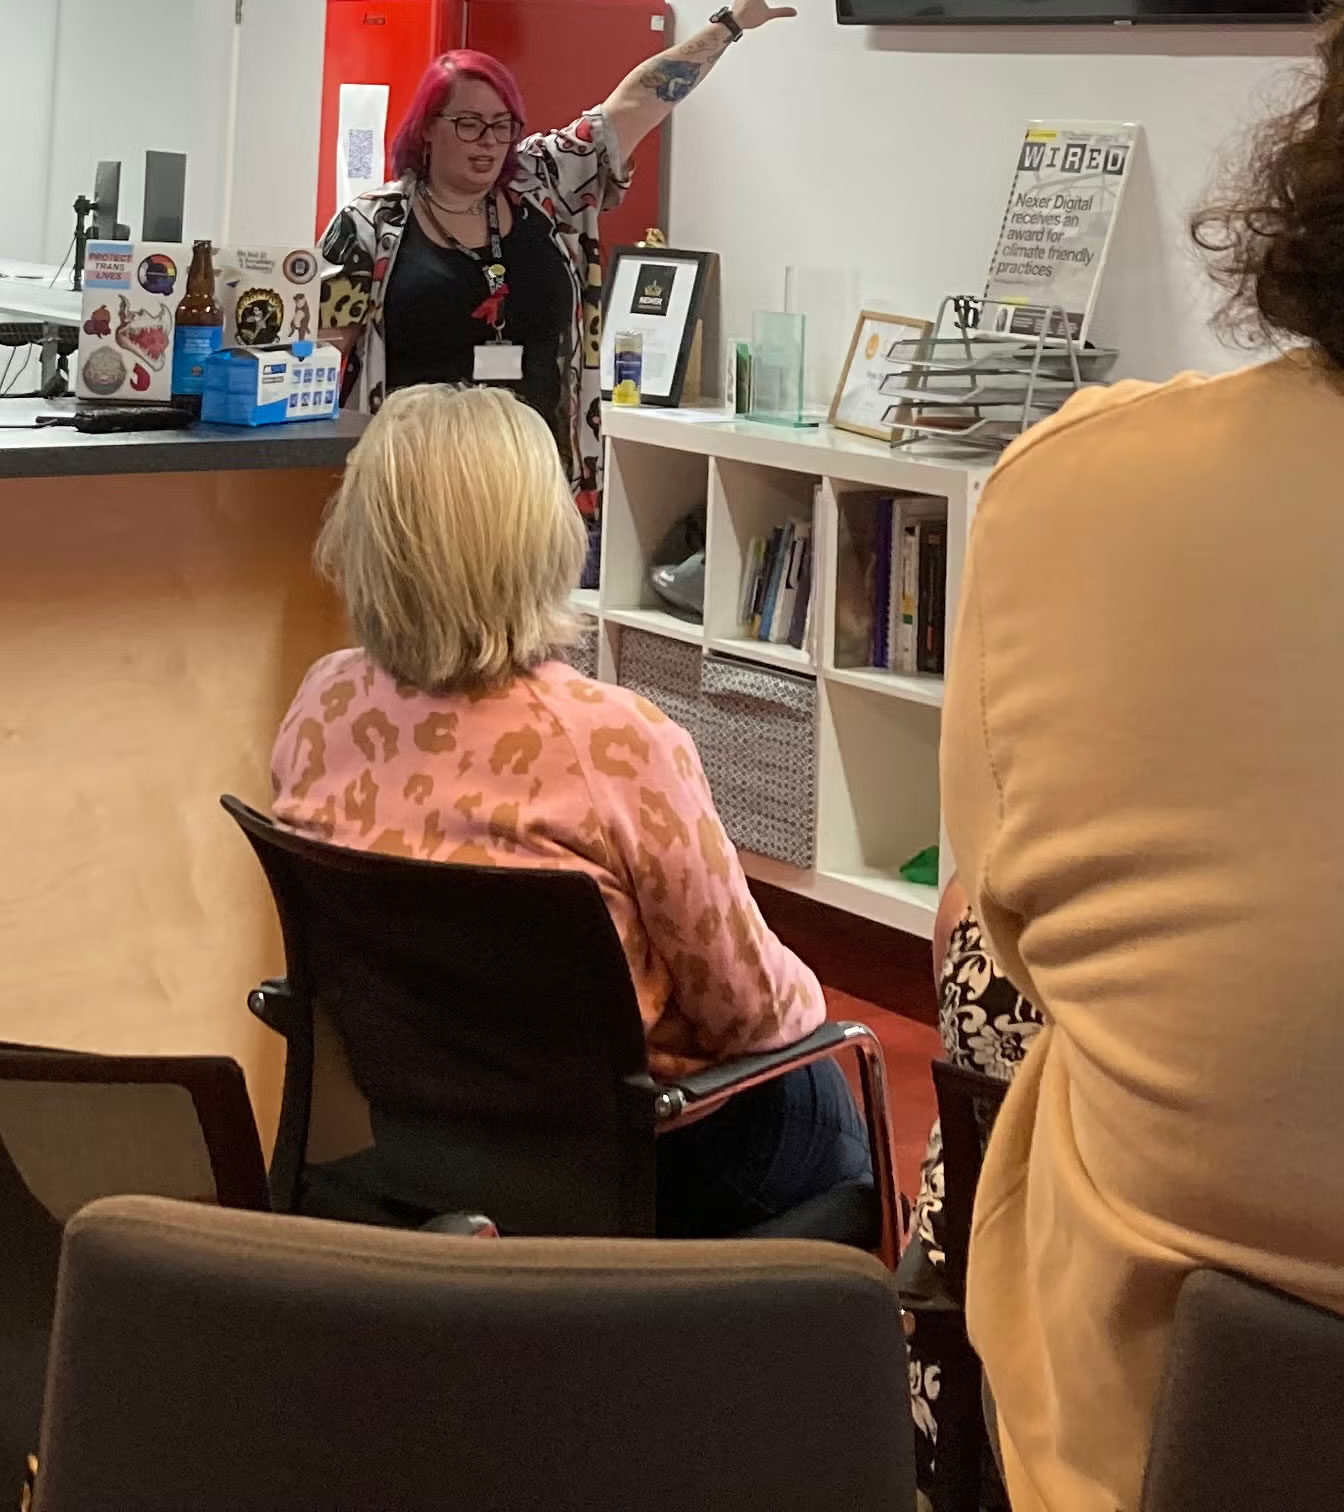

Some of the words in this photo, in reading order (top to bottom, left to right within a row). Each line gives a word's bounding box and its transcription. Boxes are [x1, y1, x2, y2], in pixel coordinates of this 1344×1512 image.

[1019, 143, 1129, 175] WIRED
[1016, 193, 1051, 209] Nexer
[1054, 195, 1094, 213] Digital
[1010, 211, 1061, 226] receives
[1062, 215, 1079, 227] an
[1007, 227, 1045, 242] award
[1047, 230, 1065, 243] for
[88, 253, 132, 263] PROTECT
[1002, 245, 1045, 260] climate
[1048, 246, 1095, 266] friendly
[96, 262, 125, 272] TRANS
[996, 260, 1053, 277] practices
[96, 271, 122, 281] LIVES
